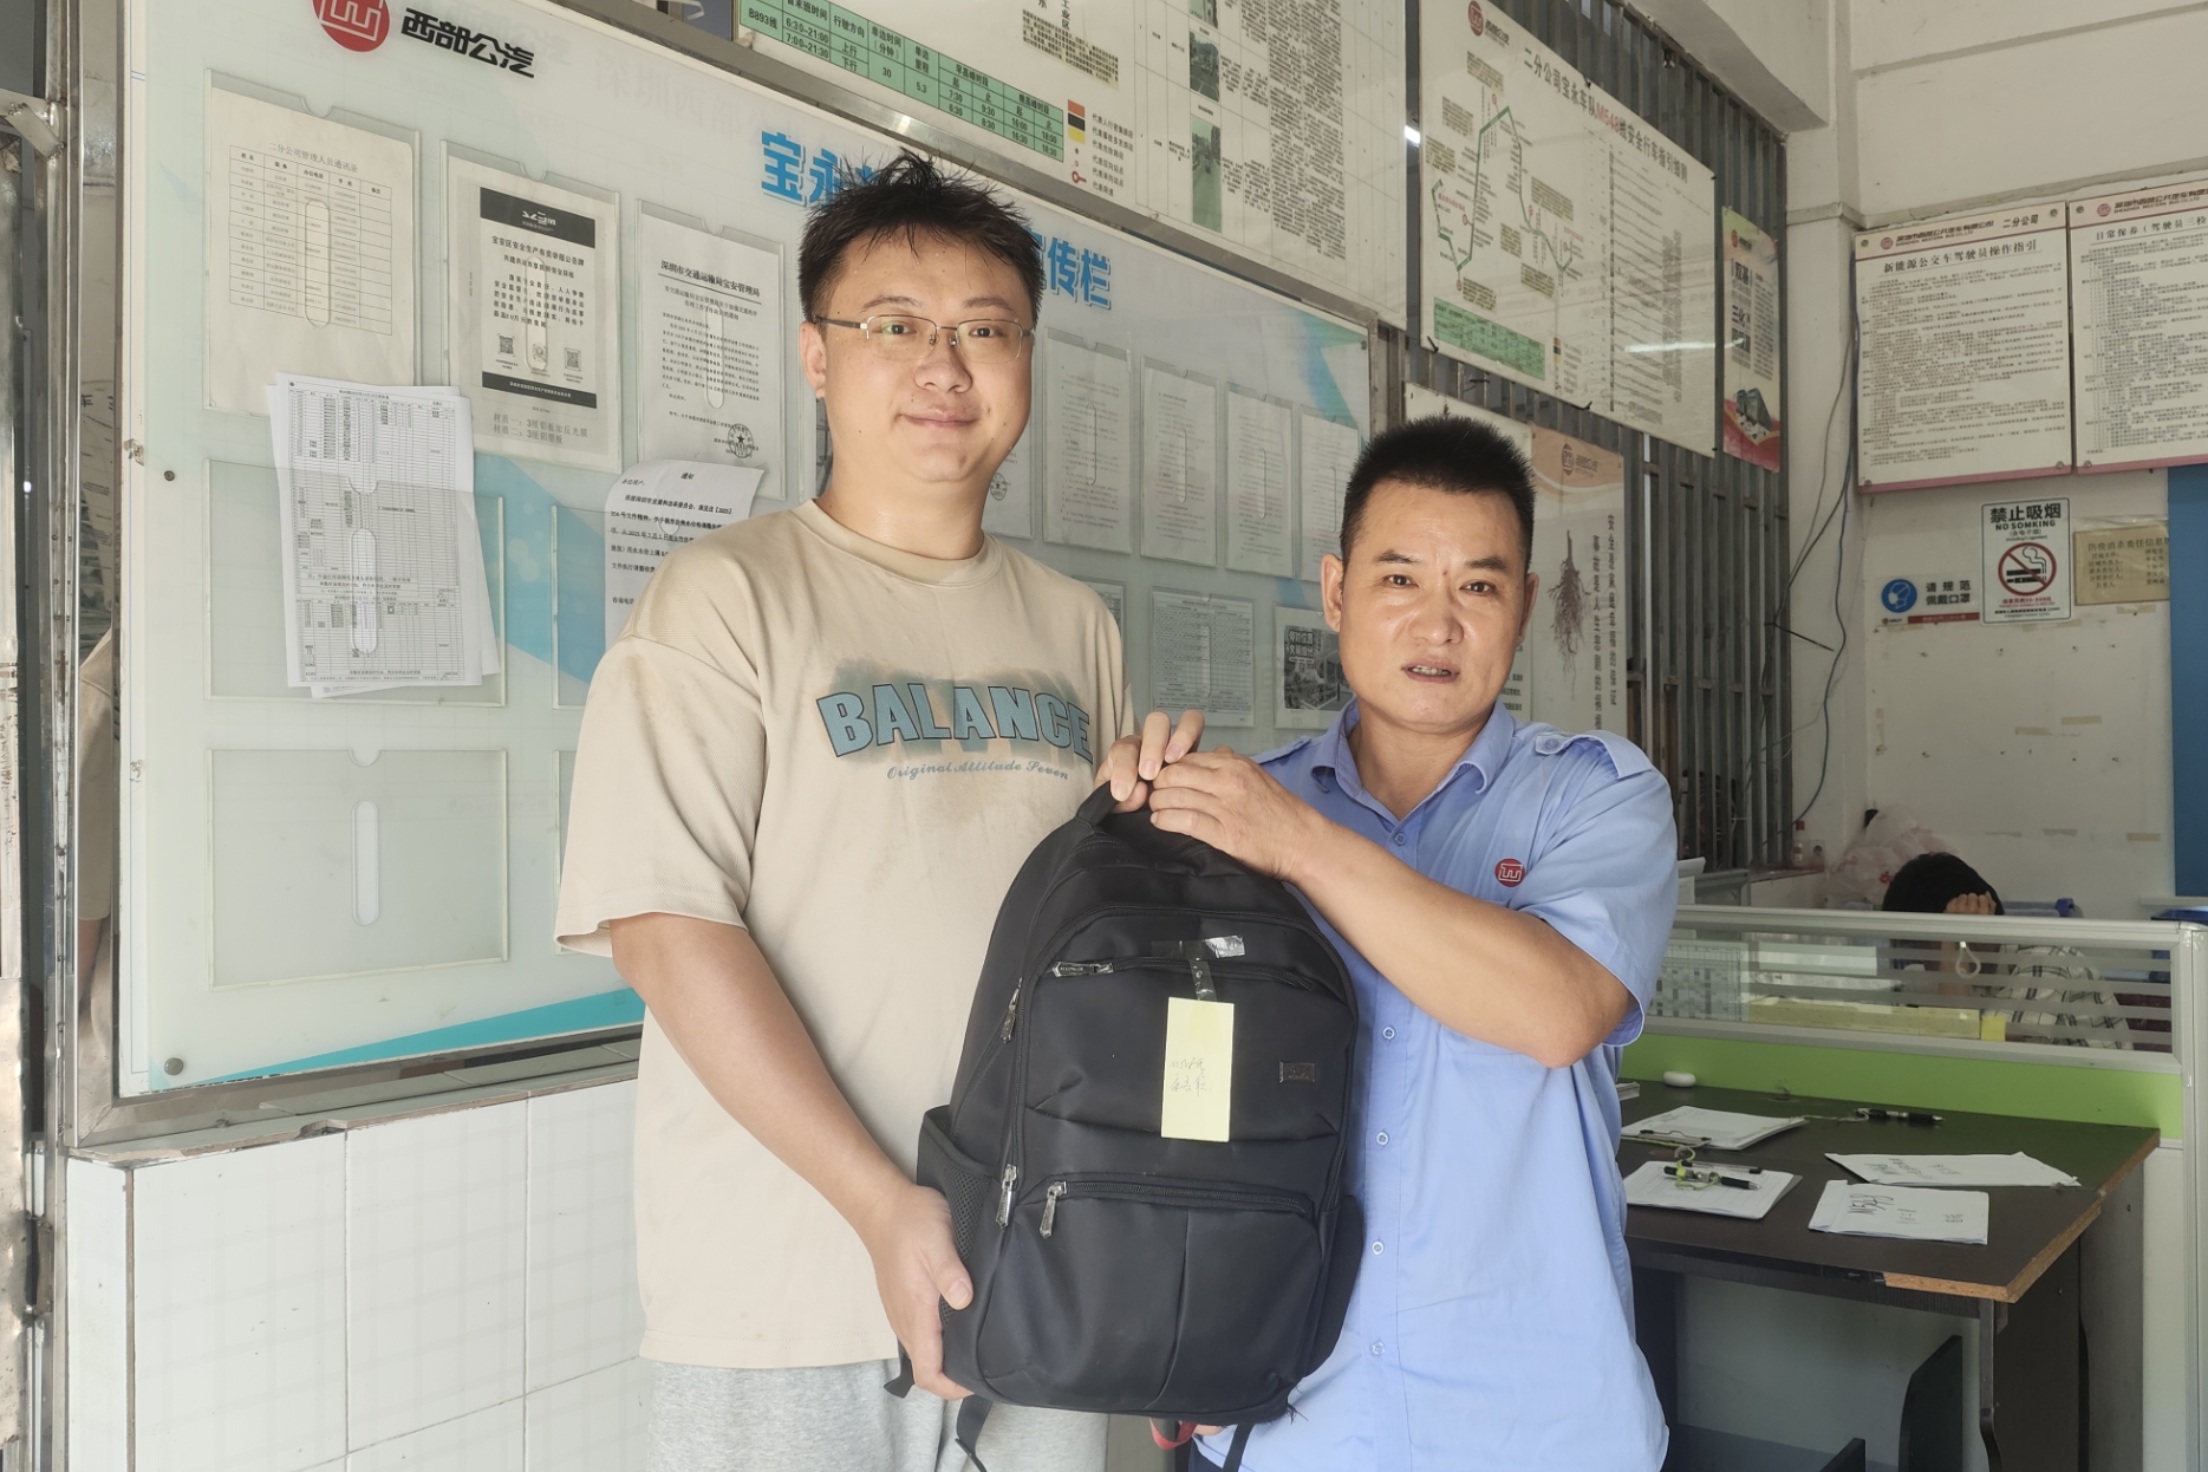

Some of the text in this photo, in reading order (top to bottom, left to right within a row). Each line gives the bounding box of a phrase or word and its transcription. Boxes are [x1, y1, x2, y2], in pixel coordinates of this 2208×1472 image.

[748, 7, 778, 31] B893线
[833, 14, 865, 38] 行驶方向
[786, 17, 829, 44] 6:30-21:00
[871, 25, 902, 48] 单边时间
[401, 7, 534, 79] 西部公汽
[786, 32, 829, 59] 7:00-21:30
[842, 41, 858, 58] 上行
[915, 45, 930, 60] 单边
[842, 55, 858, 73] 下行
[915, 58, 930, 74] 里程
[882, 66, 892, 79] 30
[955, 63, 989, 88] 早高峰时段
[915, 81, 928, 94] 5.3
[949, 89, 964, 104] 7:30
[949, 103, 964, 118] 6:30
[981, 103, 996, 118] 9:30
[981, 117, 996, 132] 8:30
[1011, 117, 1029, 133] 16:00
[1011, 130, 1029, 146] 16:30
[1041, 130, 1058, 145] 18:00
[2003, 214, 2039, 229] 二分公司
[1884, 239, 2038, 273] 新能源公交车驾驶员操作指引
[661, 259, 760, 298] 深圳市交通运输局宝安管理局
[1990, 503, 2061, 523] 禁止吸烟
[1995, 519, 2056, 531] NO SOMKING
[1926, 593, 1970, 605] 佩戴口罩
[816, 683, 1093, 764] BALANCE
[887, 760, 1069, 780] Original Attitude Seven
